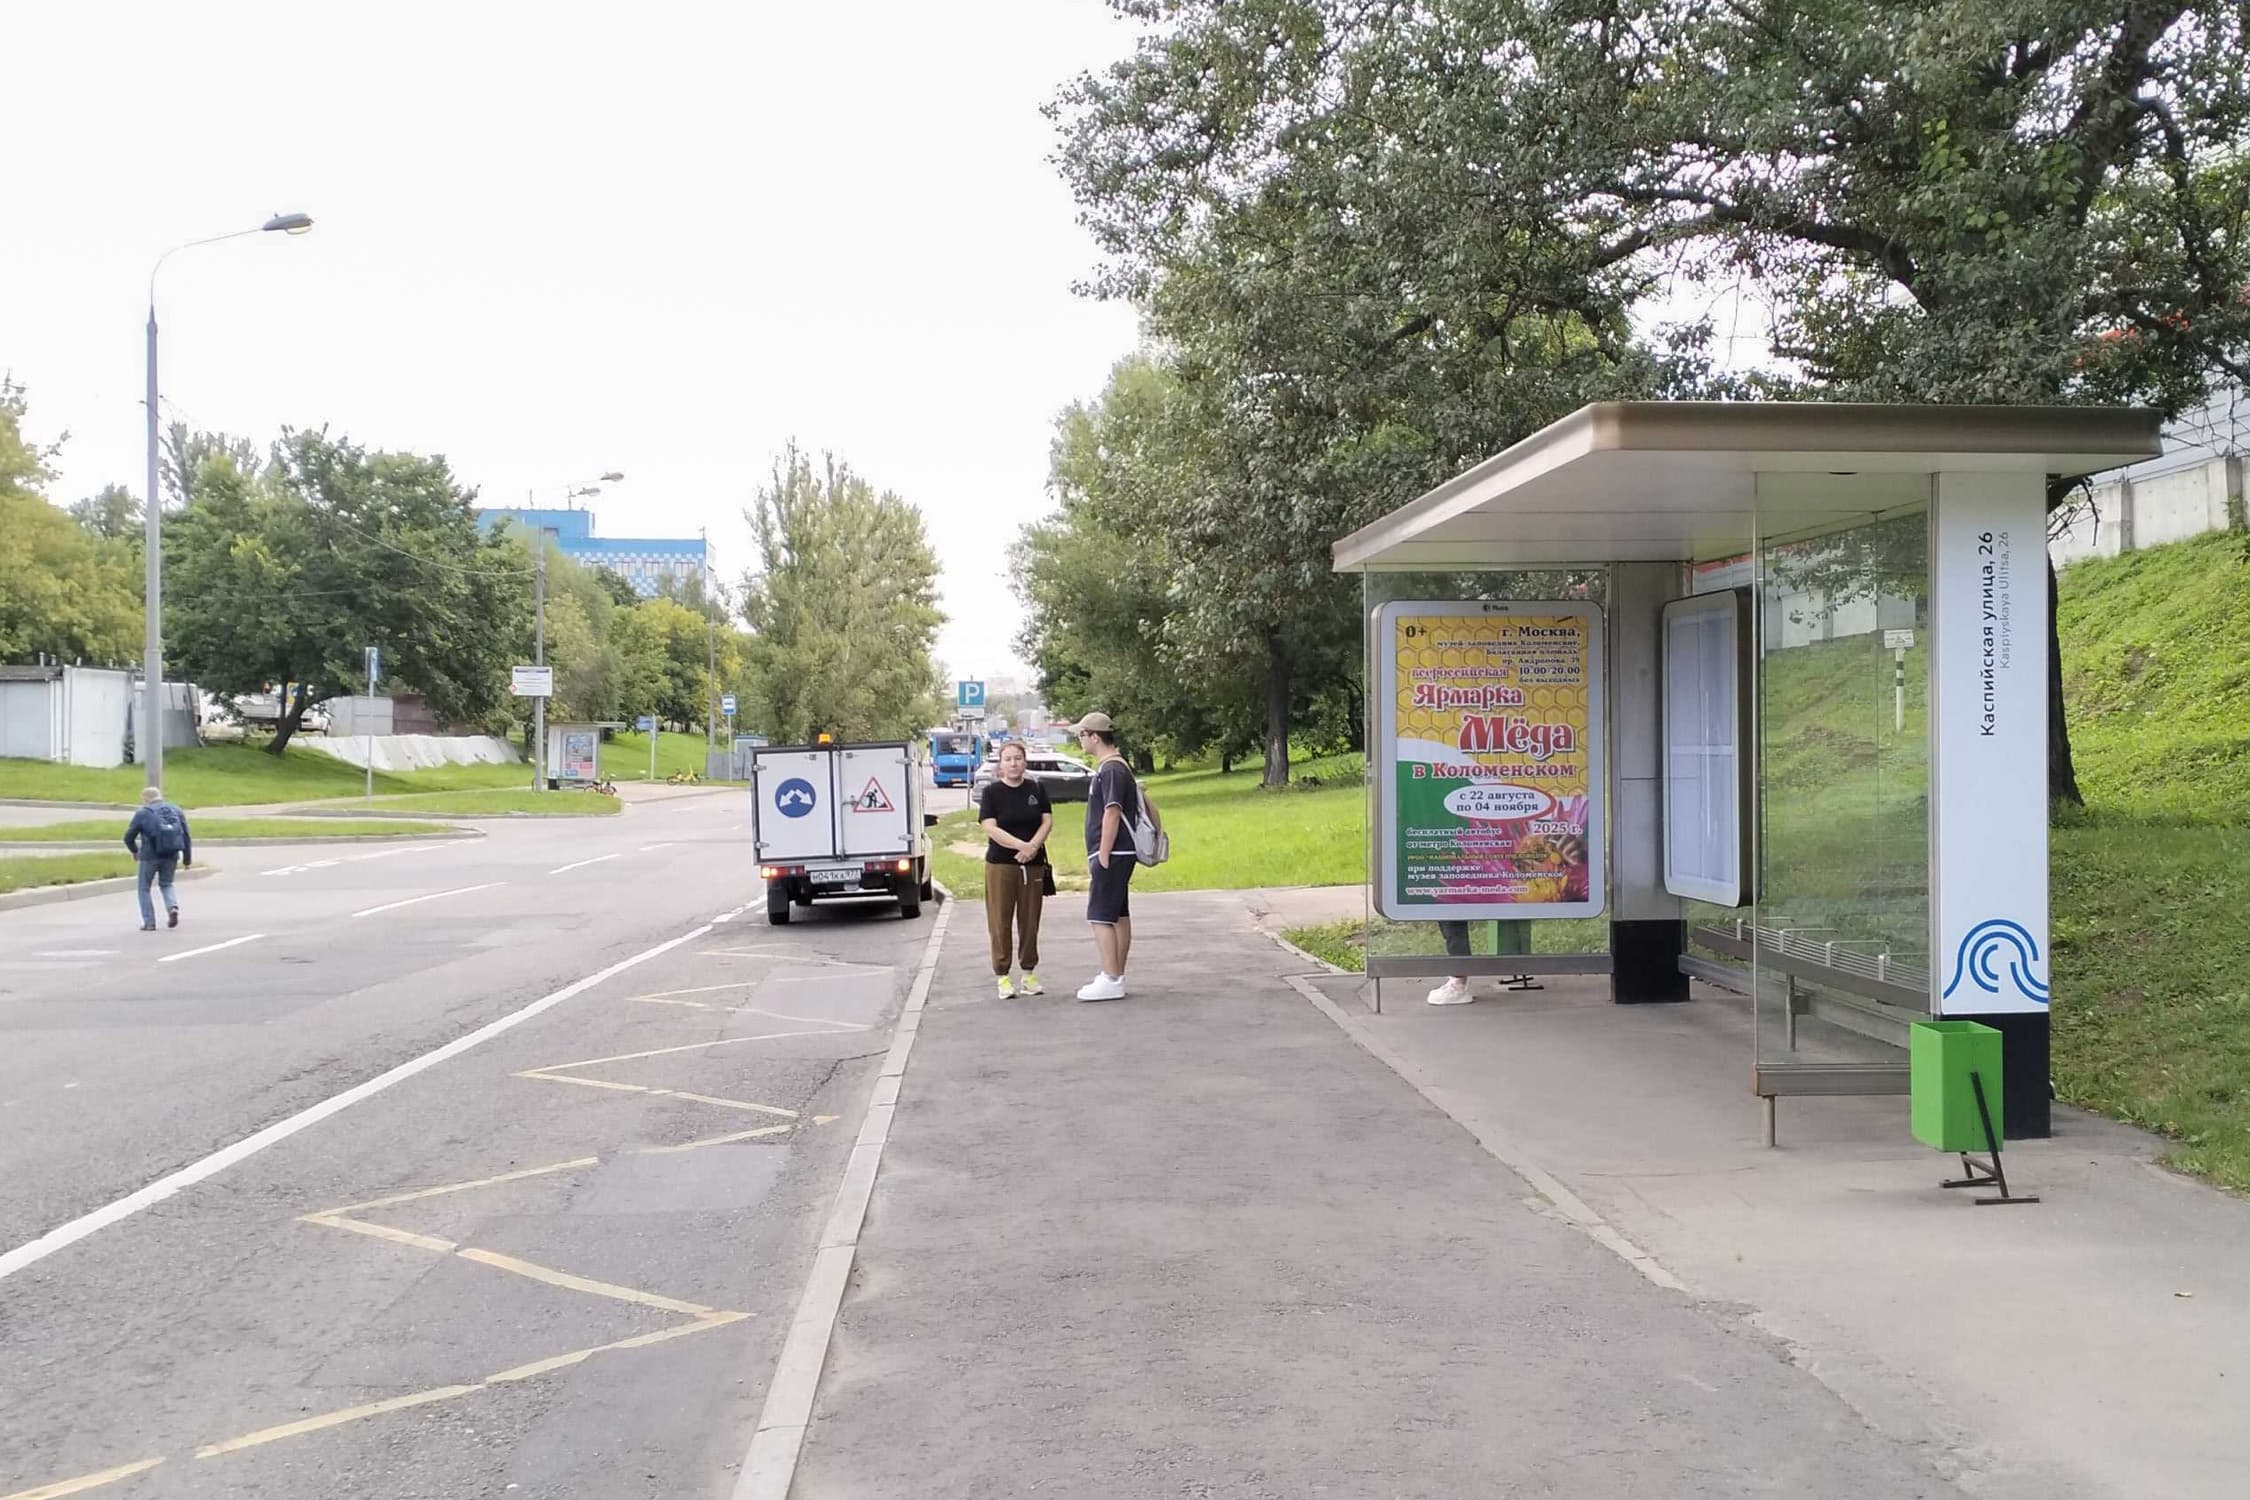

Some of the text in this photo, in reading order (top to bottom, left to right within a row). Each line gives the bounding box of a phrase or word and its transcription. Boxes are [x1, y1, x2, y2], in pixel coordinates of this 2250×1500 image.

[1998, 531, 2012, 669] Kaspiyskaya Ulitsa, 26
[1405, 624, 1427, 638] 0+
[1502, 626, 1581, 638] г. Москва,
[1978, 531, 1997, 736] Каспийская улица, 26
[1412, 667, 1509, 682] всероссийская
[1413, 684, 1524, 710] Ярмарка
[1458, 714, 1575, 760] Мёда
[1412, 762, 1576, 778] в Коломенском
[1470, 790, 1484, 800] 22
[1487, 791, 1536, 802] августа
[1456, 801, 1539, 813] по 04 ноября
[1533, 823, 1583, 834] 2025 г.
